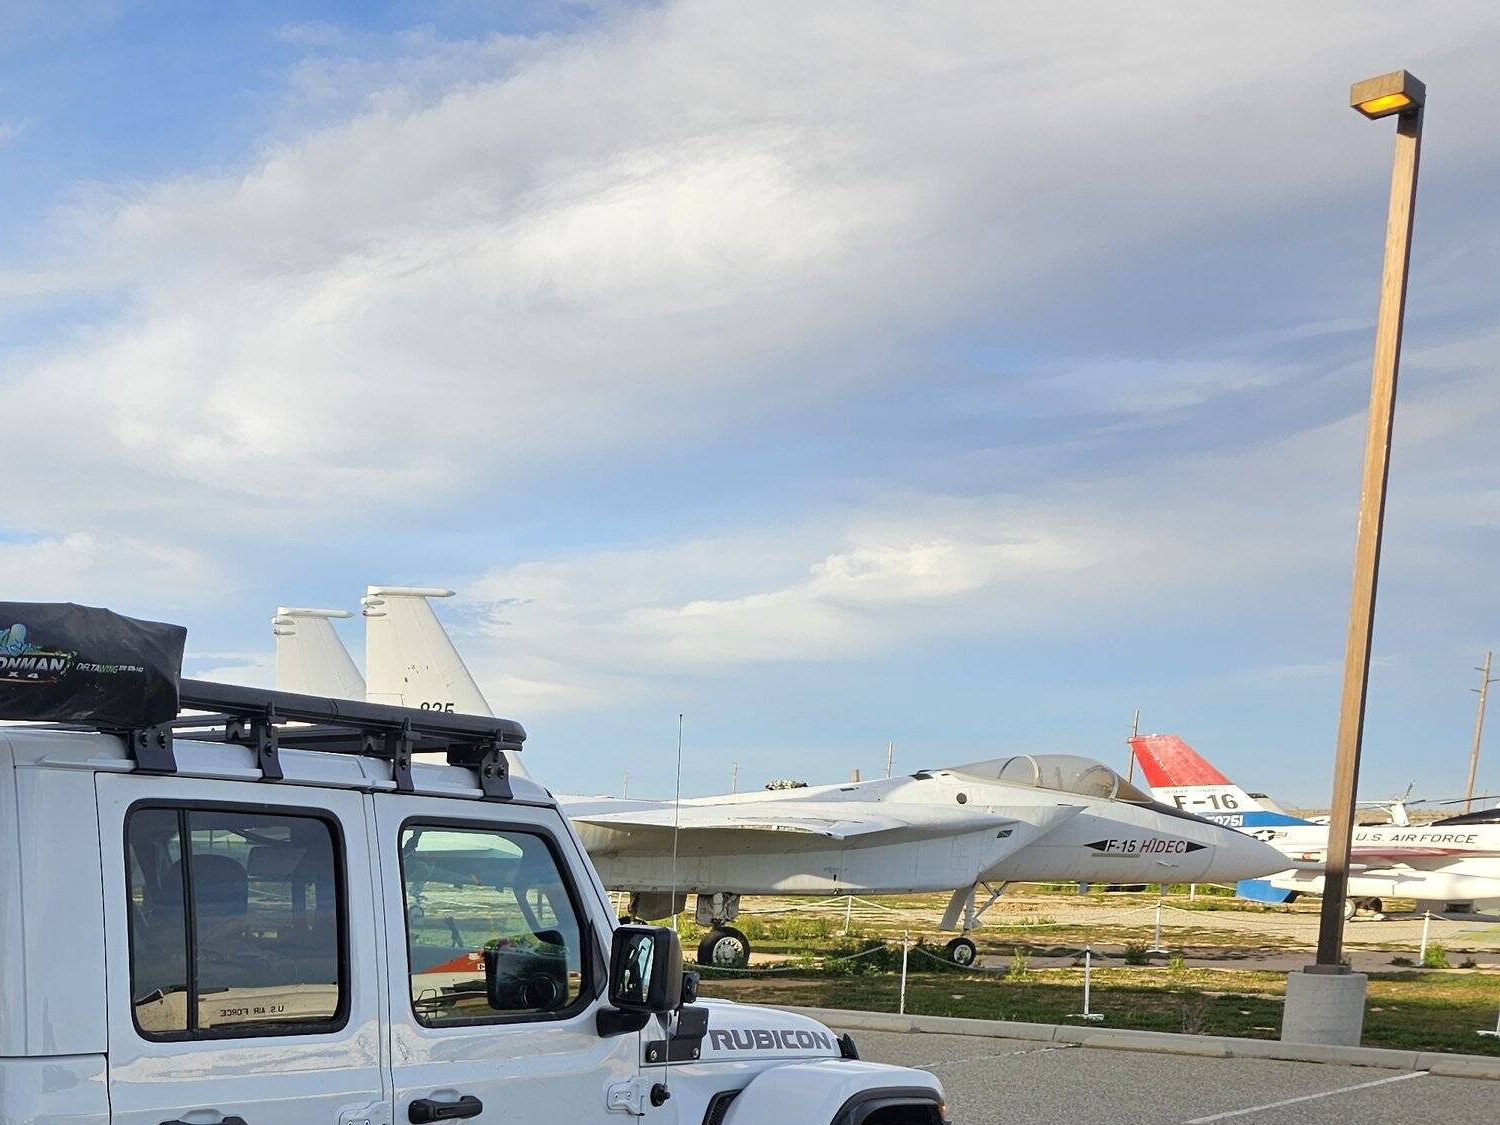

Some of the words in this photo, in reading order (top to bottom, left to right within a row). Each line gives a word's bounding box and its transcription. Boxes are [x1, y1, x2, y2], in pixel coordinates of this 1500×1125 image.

[1173, 793, 1239, 810] F-16
[1104, 839, 1136, 853] F-15
[1139, 838, 1186, 853] HIDEC
[1356, 833, 1384, 842] U.S.
[1391, 834, 1417, 842] AIR
[1420, 834, 1478, 844] FORCE
[708, 1029, 832, 1051] RUBICON
